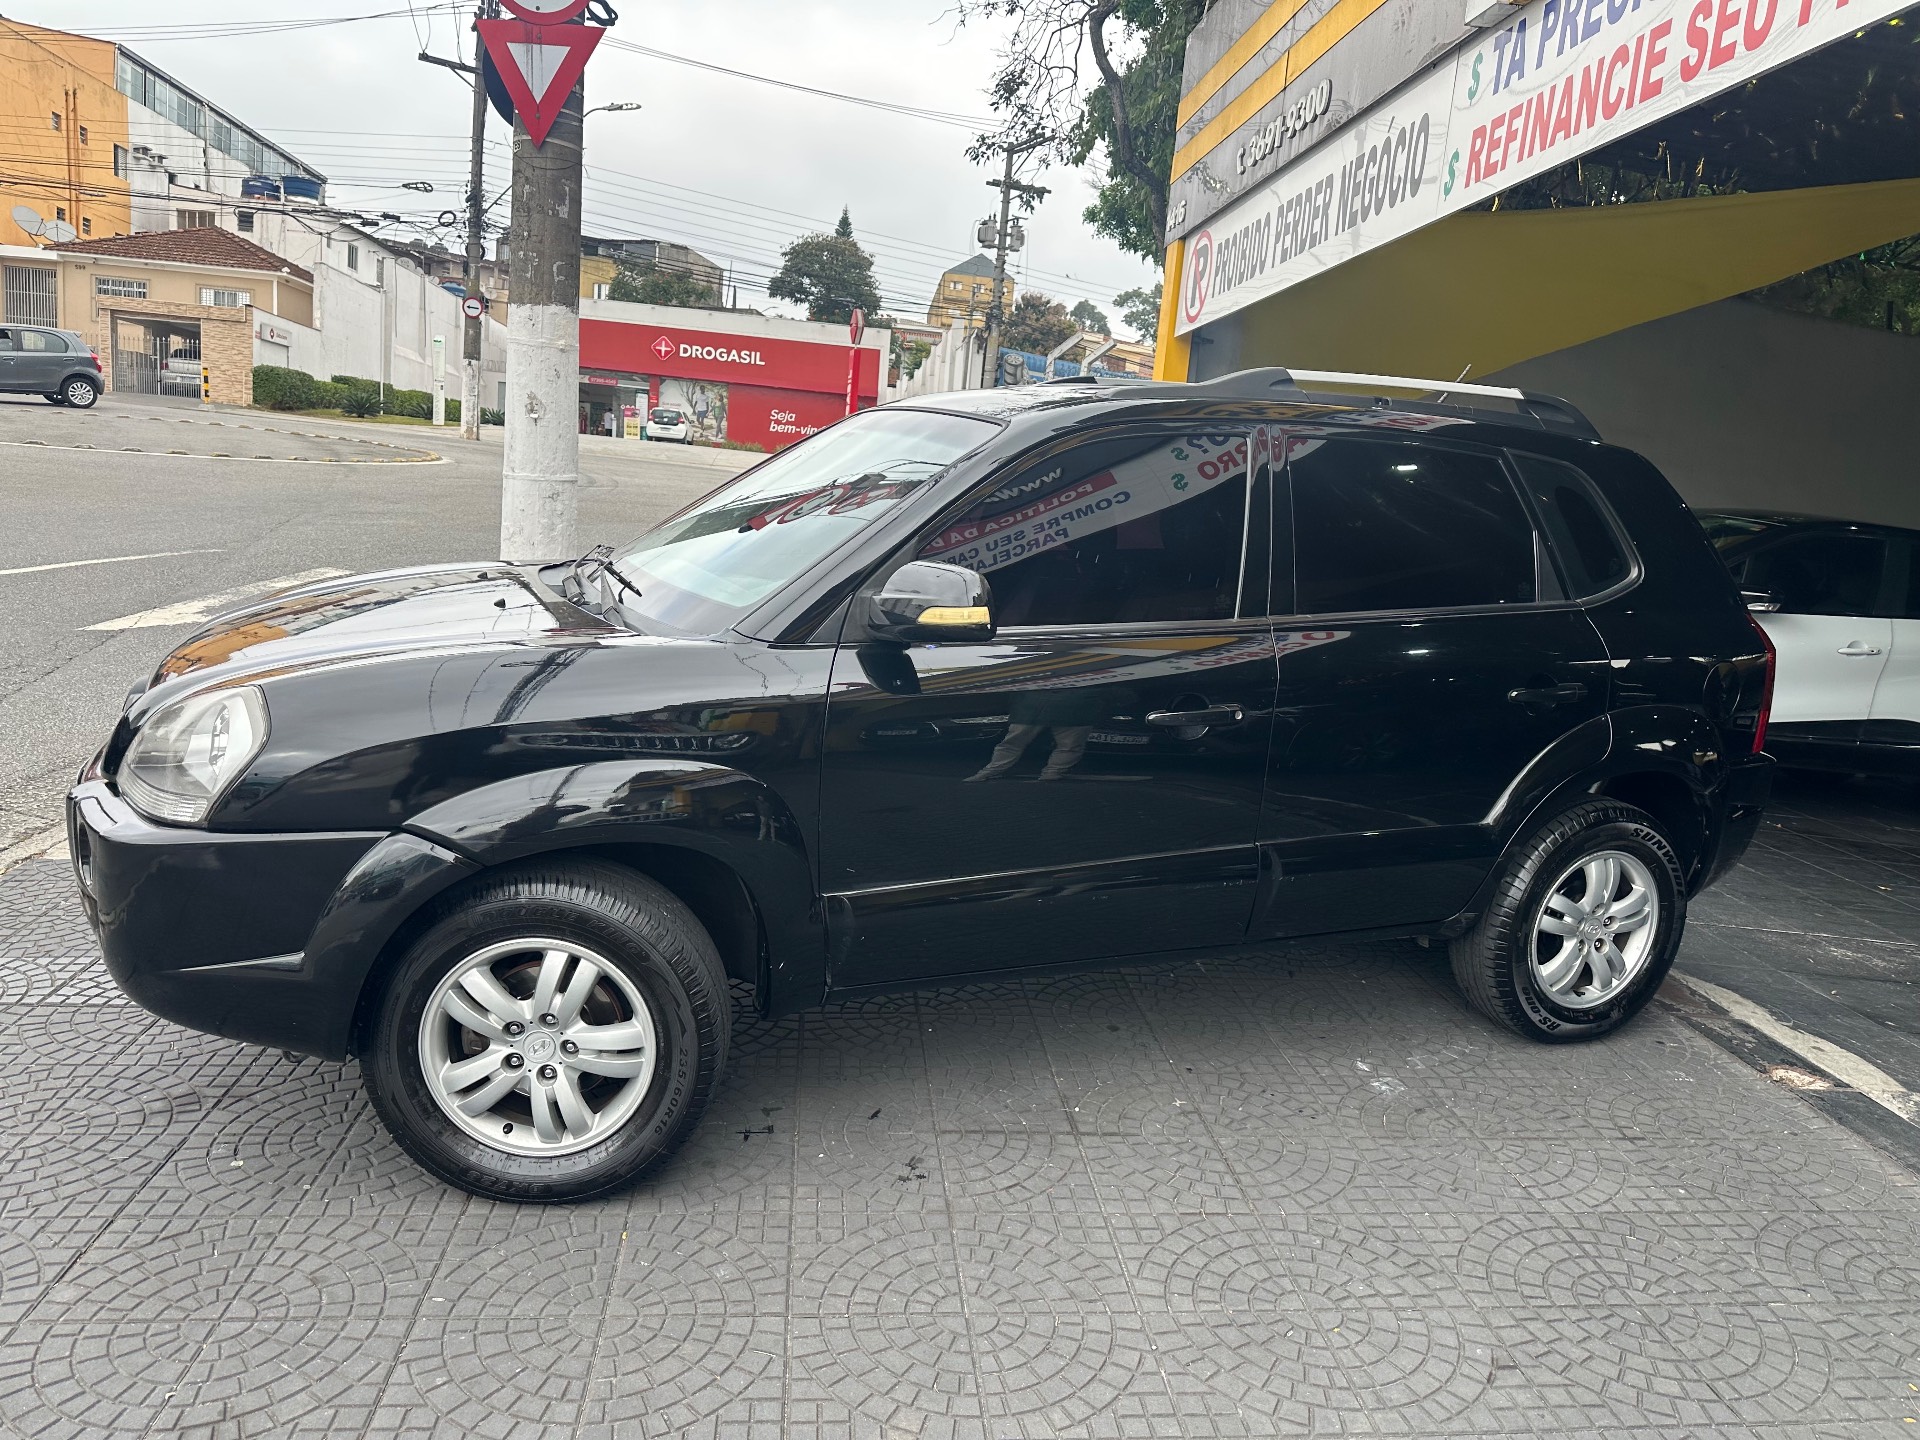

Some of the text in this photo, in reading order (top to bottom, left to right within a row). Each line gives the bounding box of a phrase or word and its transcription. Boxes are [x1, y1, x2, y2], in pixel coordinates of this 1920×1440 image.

[1467, 0, 1641, 105] $ TA PRE
[1247, 79, 1332, 167] 3691-9300
[1443, 0, 1779, 201] $ REFINANCIE SEU
[1212, 112, 1430, 298] PROIBIDO PERDER NEGÓCIO
[679, 343, 766, 366] DROGASIL
[769, 409, 796, 423] Seja
[769, 421, 826, 435] bem-vin
[654, 1046, 688, 1136] 235/60R16
